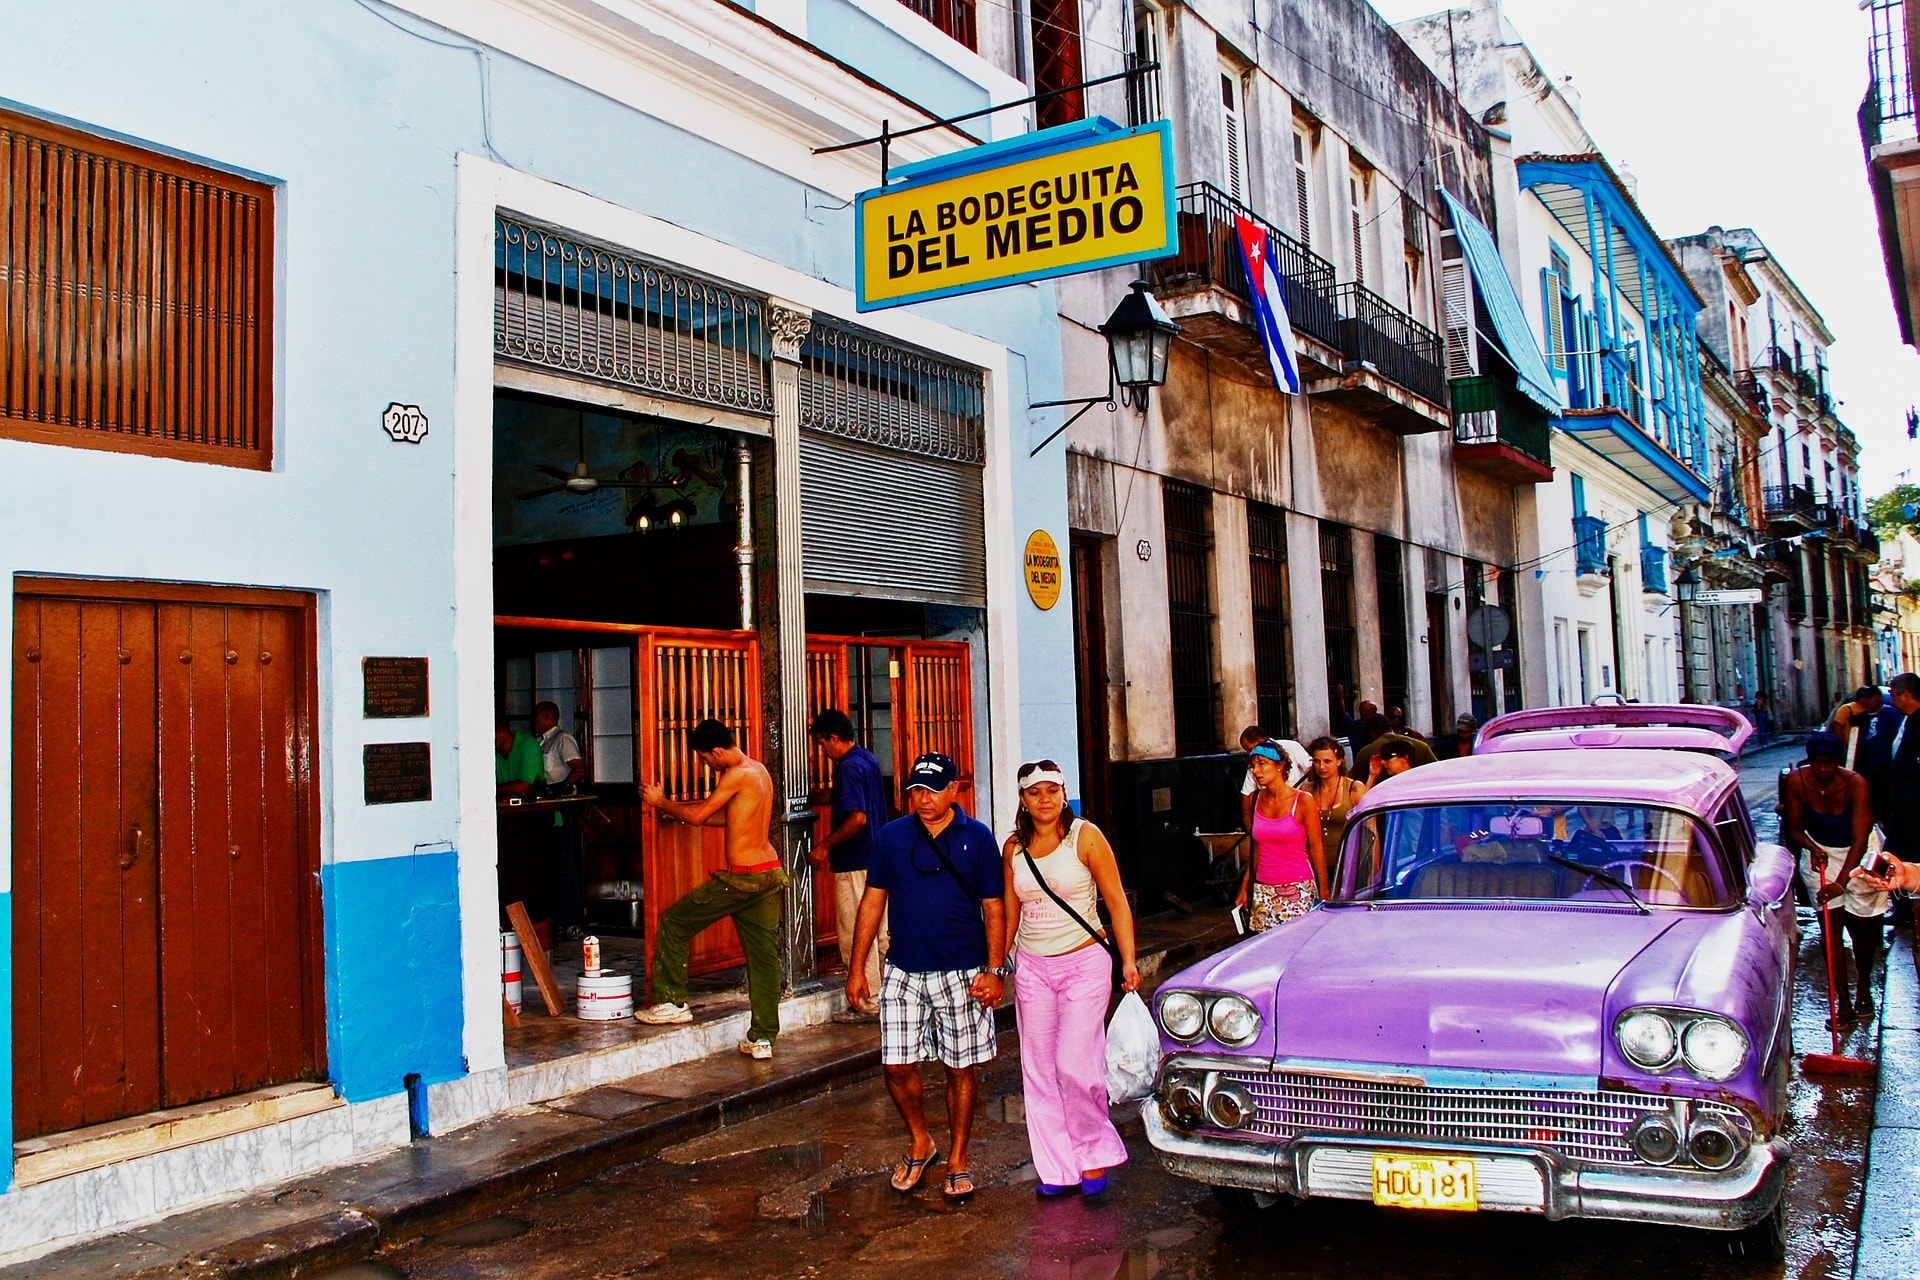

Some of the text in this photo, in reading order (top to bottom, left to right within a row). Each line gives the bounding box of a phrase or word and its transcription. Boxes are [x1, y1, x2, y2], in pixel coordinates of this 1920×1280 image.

[887, 161, 1140, 243] LA BODEGUITA
[888, 195, 1144, 280] DEL MEDIO
[392, 412, 420, 436] 207
[1025, 554, 1059, 568] LA BODEGUITA
[1031, 570, 1057, 585] DEL MEDIO
[1375, 1170, 1469, 1199] HDU 181
